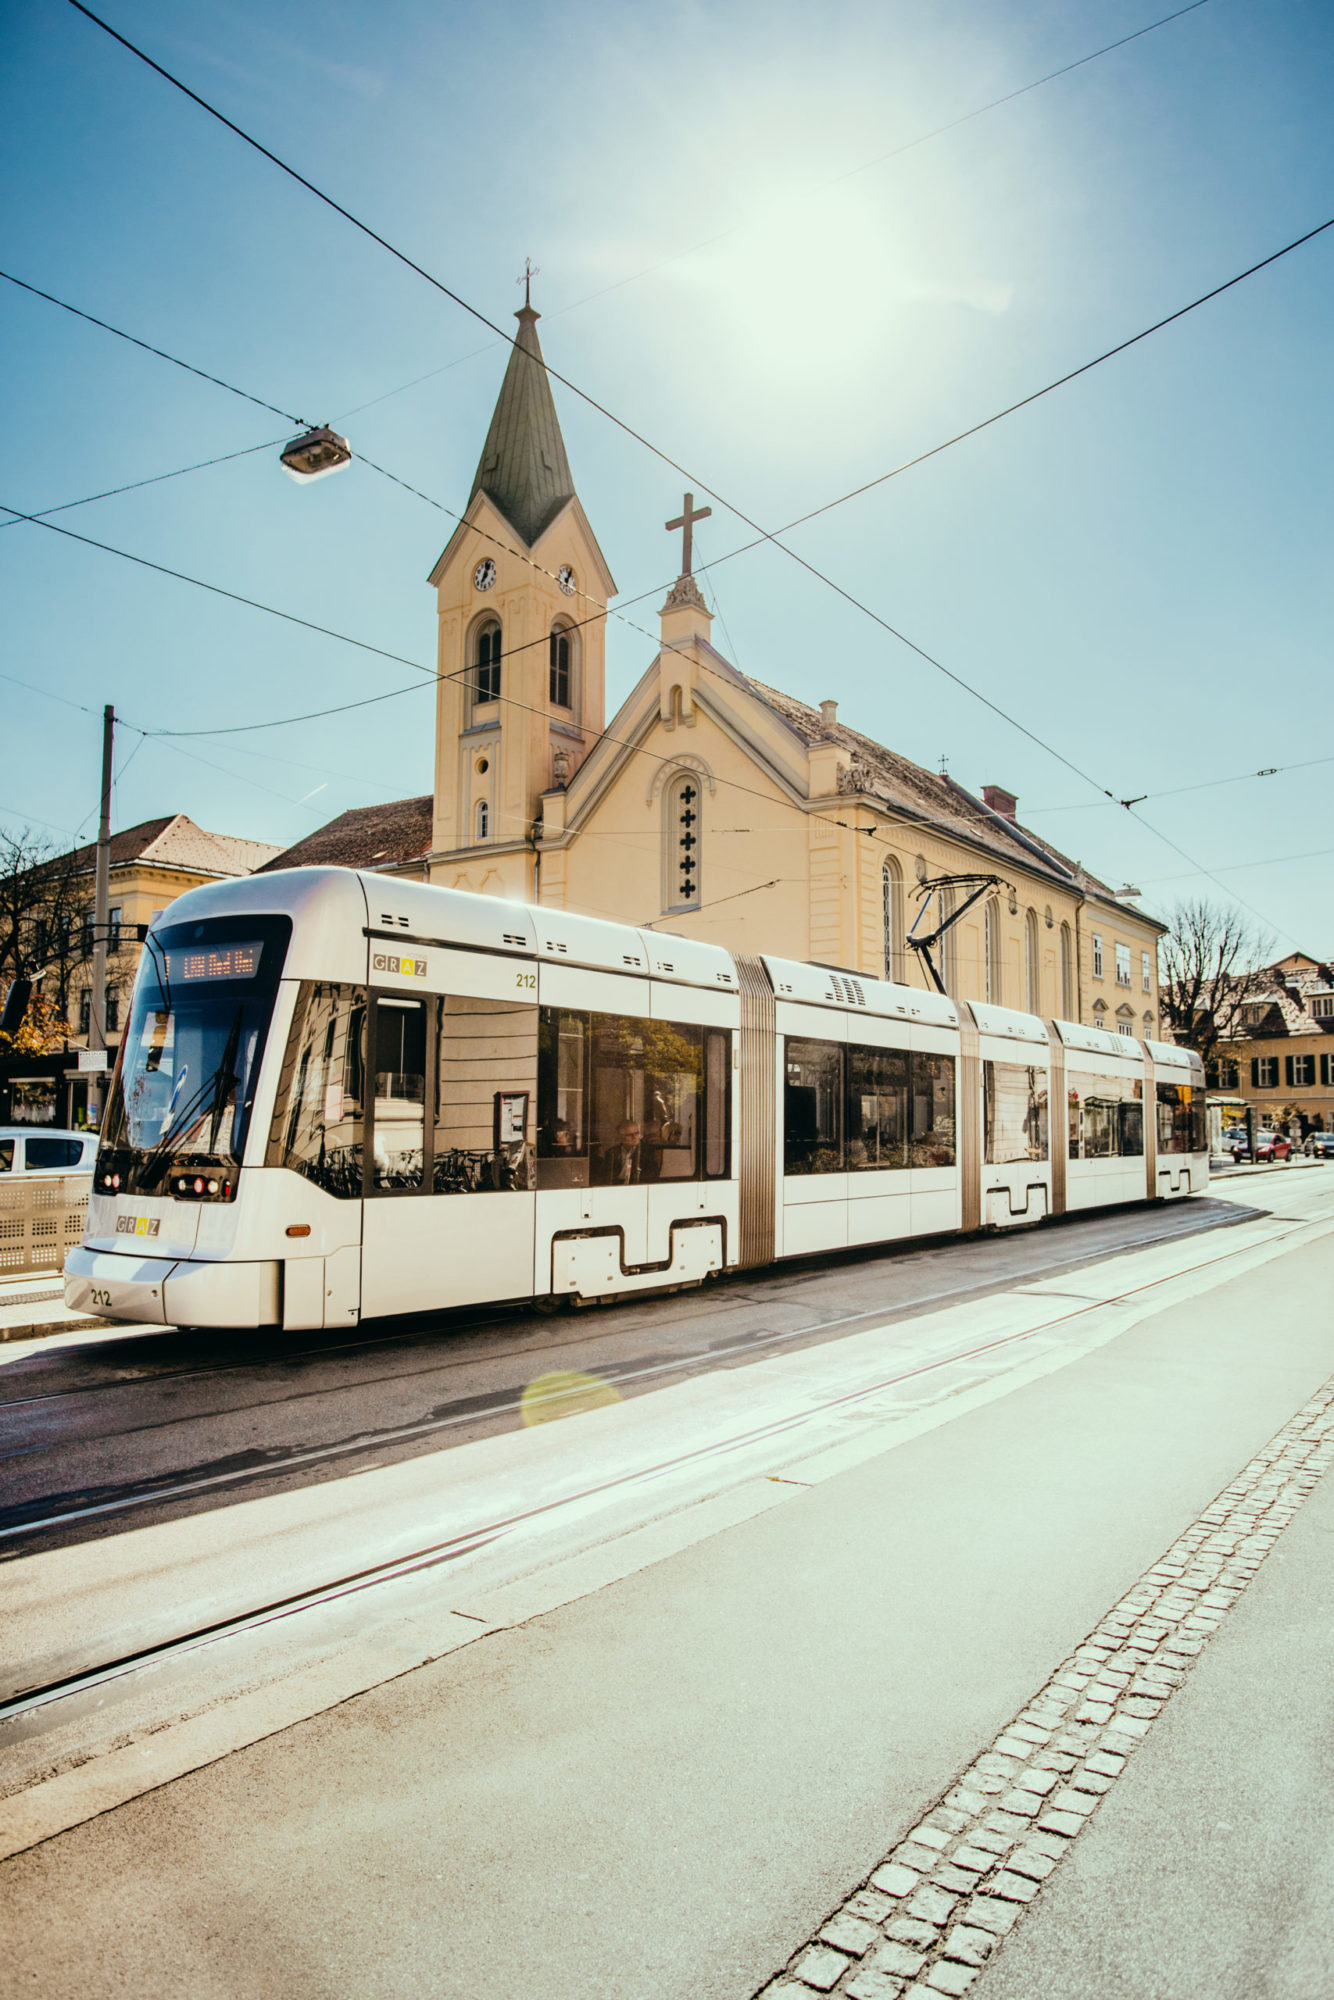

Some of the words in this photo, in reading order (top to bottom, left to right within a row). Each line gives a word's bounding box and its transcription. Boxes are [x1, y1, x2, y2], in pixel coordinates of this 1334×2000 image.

[234, 949, 253, 974] Uni
[374, 955, 426, 976] GRAZ
[516, 973, 536, 989] 212
[116, 1216, 159, 1235] GRAZ
[91, 1288, 112, 1306] 212
